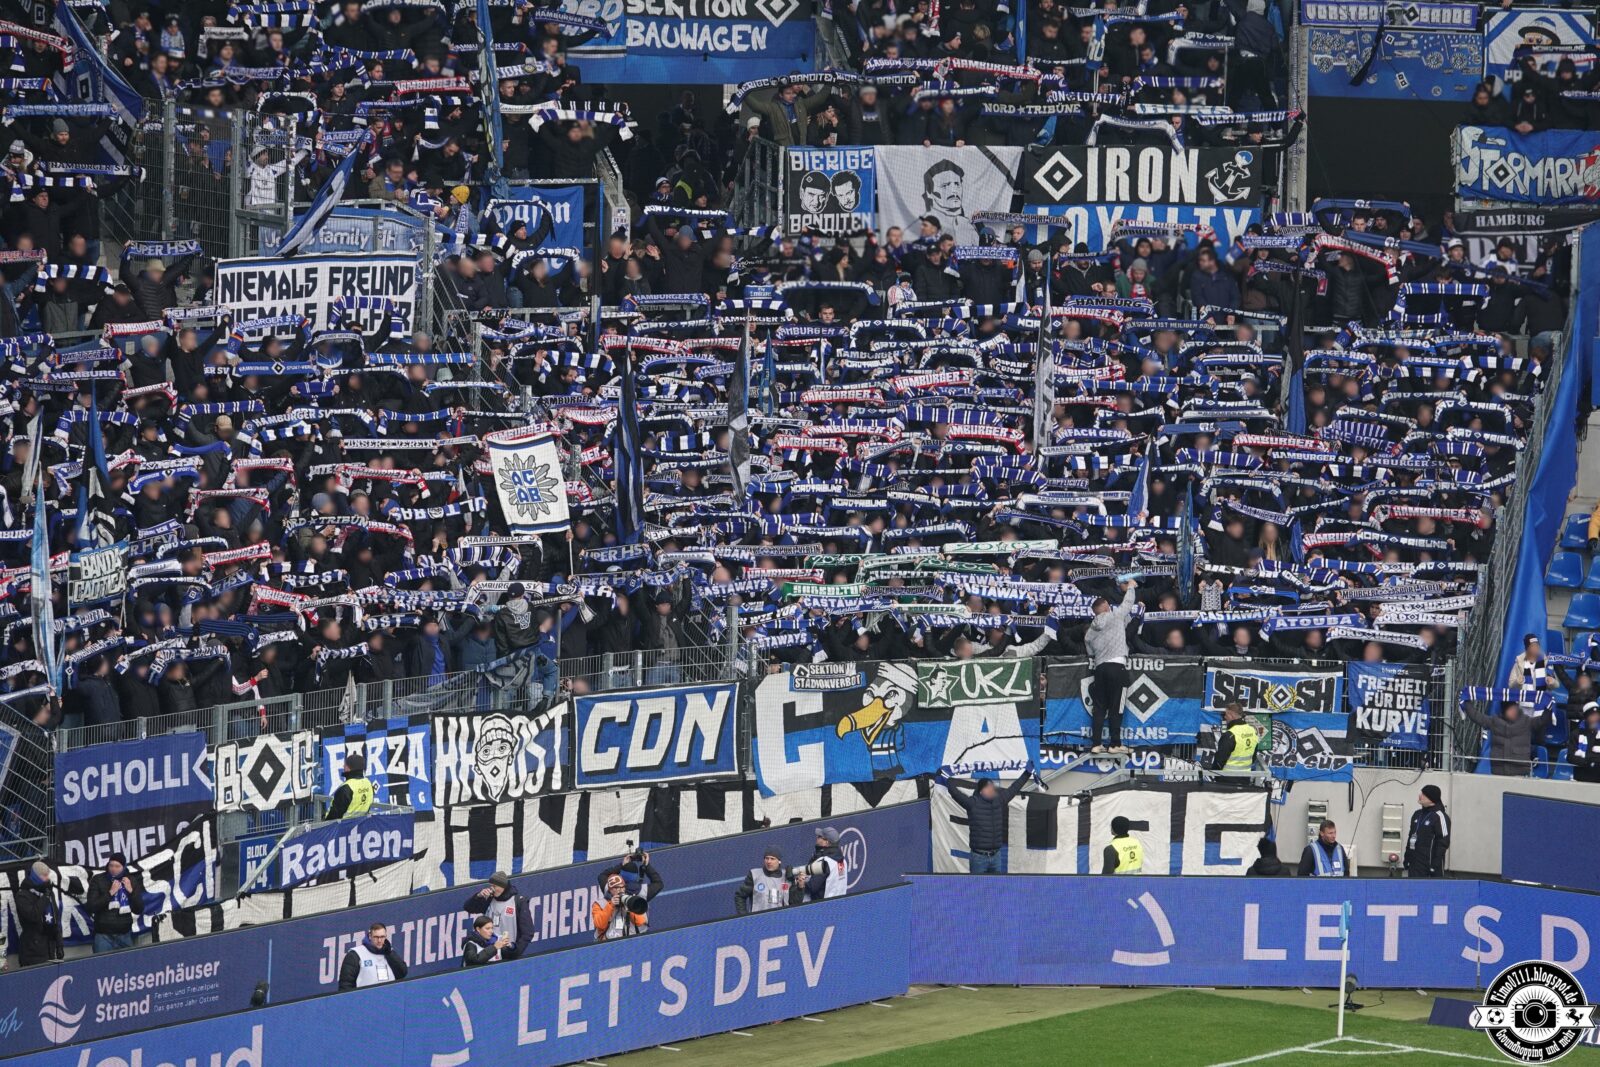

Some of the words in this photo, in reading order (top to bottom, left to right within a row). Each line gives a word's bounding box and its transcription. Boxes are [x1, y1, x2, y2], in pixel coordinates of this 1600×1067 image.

[626, 19, 768, 52] BAUWAGEN
[1076, 91, 1123, 104] LOYALTY
[984, 103, 1014, 114] NORD
[1024, 103, 1081, 115] TRIBÜNE
[50, 162, 112, 173] HAMBURGER
[789, 150, 873, 171] BIERIGE
[1086, 147, 1199, 204] IRON
[1475, 214, 1545, 228] HAMBURG
[166, 241, 198, 254] HSV
[955, 249, 1005, 259] HAMBURGER
[220, 267, 318, 304] NIEMALS
[328, 265, 414, 298] FREUND
[1076, 298, 1142, 308] HAMBURG
[1227, 354, 1264, 363] MOIN
[50, 370, 117, 380] HAMBURG
[895, 373, 957, 388] HAMBURGER
[804, 391, 869, 404] HAMBURGER
[253, 408, 317, 428] HAMBURGER
[347, 439, 383, 449] UNSER
[395, 439, 437, 449] VEREIN
[1272, 452, 1337, 463] HAMBURGER
[1366, 457, 1429, 468] HAMBURGER
[1394, 506, 1466, 519] HAMBURGER
[80, 545, 121, 580] BANDA
[1275, 613, 1352, 628] ATOUBA
[810, 663, 845, 676] SEKTION
[794, 673, 862, 691] STADIONVERBOT
[1357, 674, 1428, 696] FREIHEIT
[1295, 676, 1337, 713] SH
[1364, 691, 1393, 708] FÜR
[1396, 692, 1423, 711] DIE
[1356, 706, 1428, 736] KURVE
[62, 752, 189, 806] SCHOLLI
[246, 844, 268, 858] BLOCK
[281, 825, 413, 887] Rauten-
[1243, 902, 1504, 965] LET'S
[96, 959, 220, 998] Weissenhäuser
[517, 954, 688, 1046] LET'S
[713, 925, 835, 1007] DEV
[96, 994, 150, 1024] Strand
